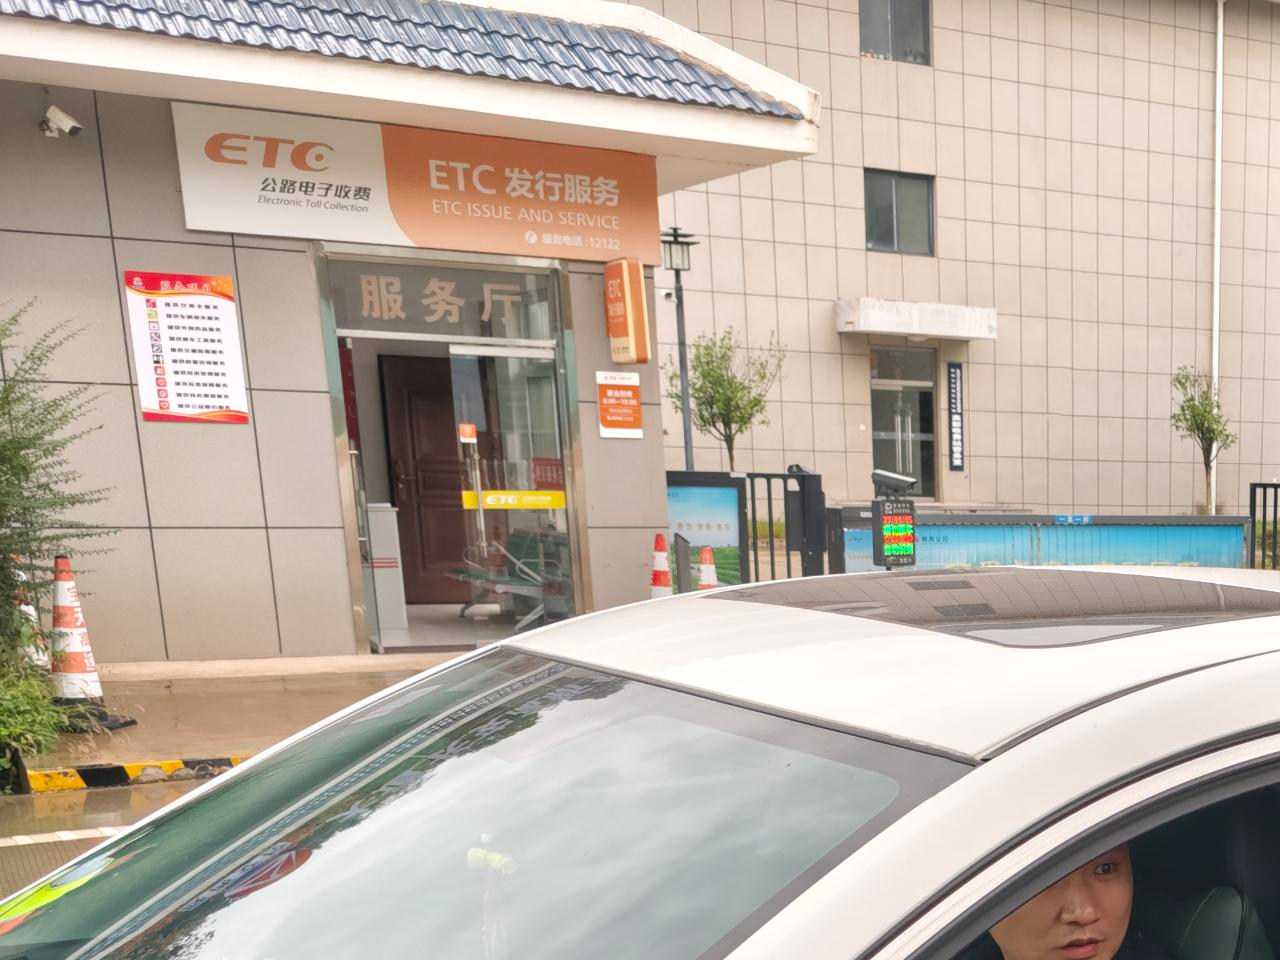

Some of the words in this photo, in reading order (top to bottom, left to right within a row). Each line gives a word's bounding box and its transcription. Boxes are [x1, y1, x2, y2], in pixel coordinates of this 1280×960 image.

[204, 132, 335, 172] ETC
[259, 177, 372, 202] 公路电子收费
[428, 159, 497, 195] ETC
[504, 167, 620, 207] 发行服务
[257, 195, 303, 207] Electronic
[305, 198, 322, 209] Toll
[323, 200, 369, 213] Collection
[431, 199, 463, 216] ETC
[468, 202, 512, 220] ISSUE
[518, 207, 553, 225] AND
[559, 211, 621, 230] SERVICE
[360, 274, 522, 323] 服务厅
[608, 278, 622, 298] ETC
